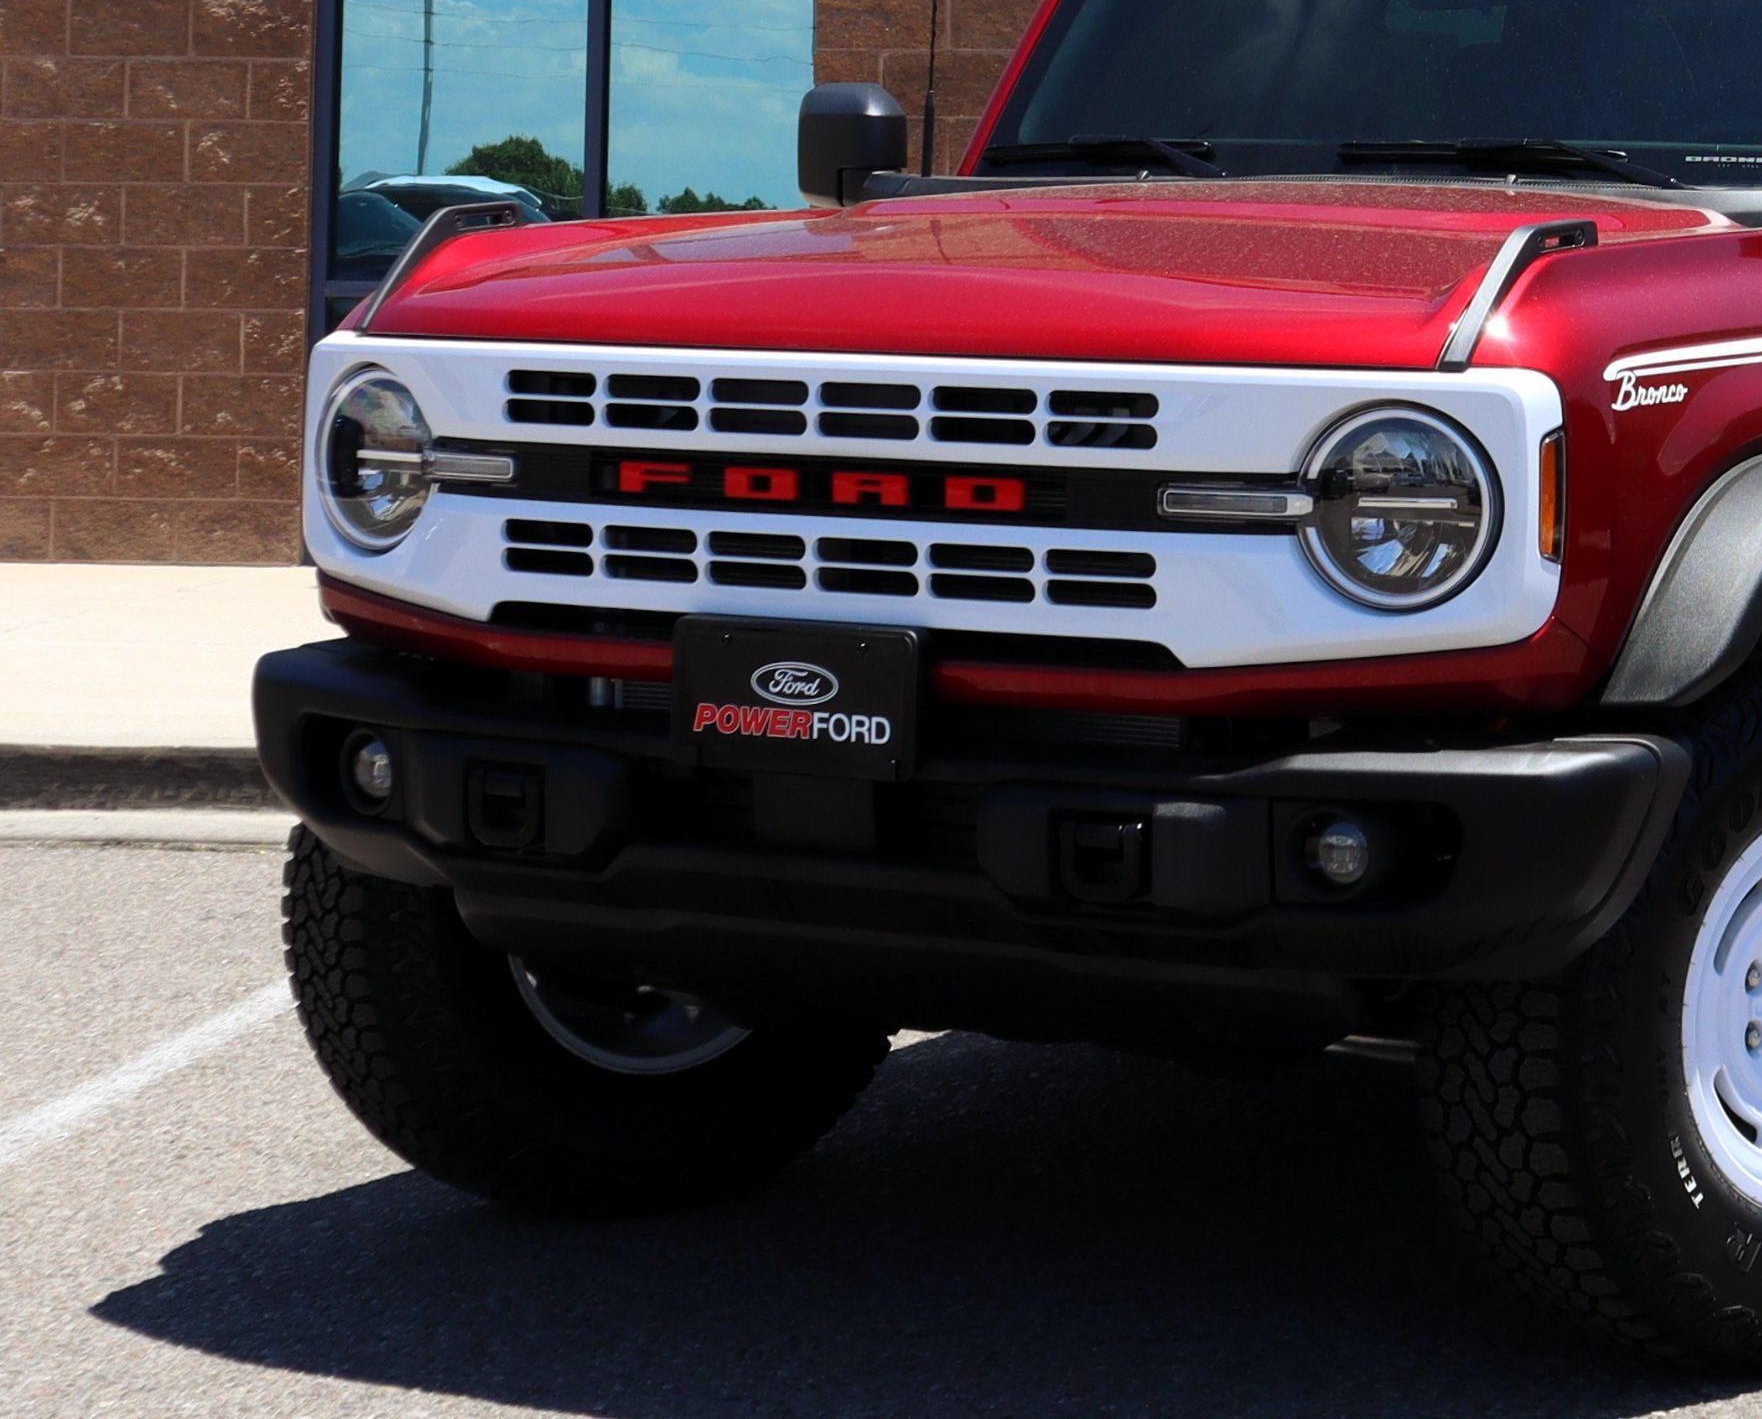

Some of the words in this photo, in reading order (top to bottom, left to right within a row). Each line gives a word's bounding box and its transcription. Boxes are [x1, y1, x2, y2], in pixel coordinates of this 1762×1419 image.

[1611, 370, 1689, 411] Bronco
[619, 461, 1026, 512] FORD
[768, 669, 821, 697] Ford
[693, 703, 892, 745] POWERFORD
